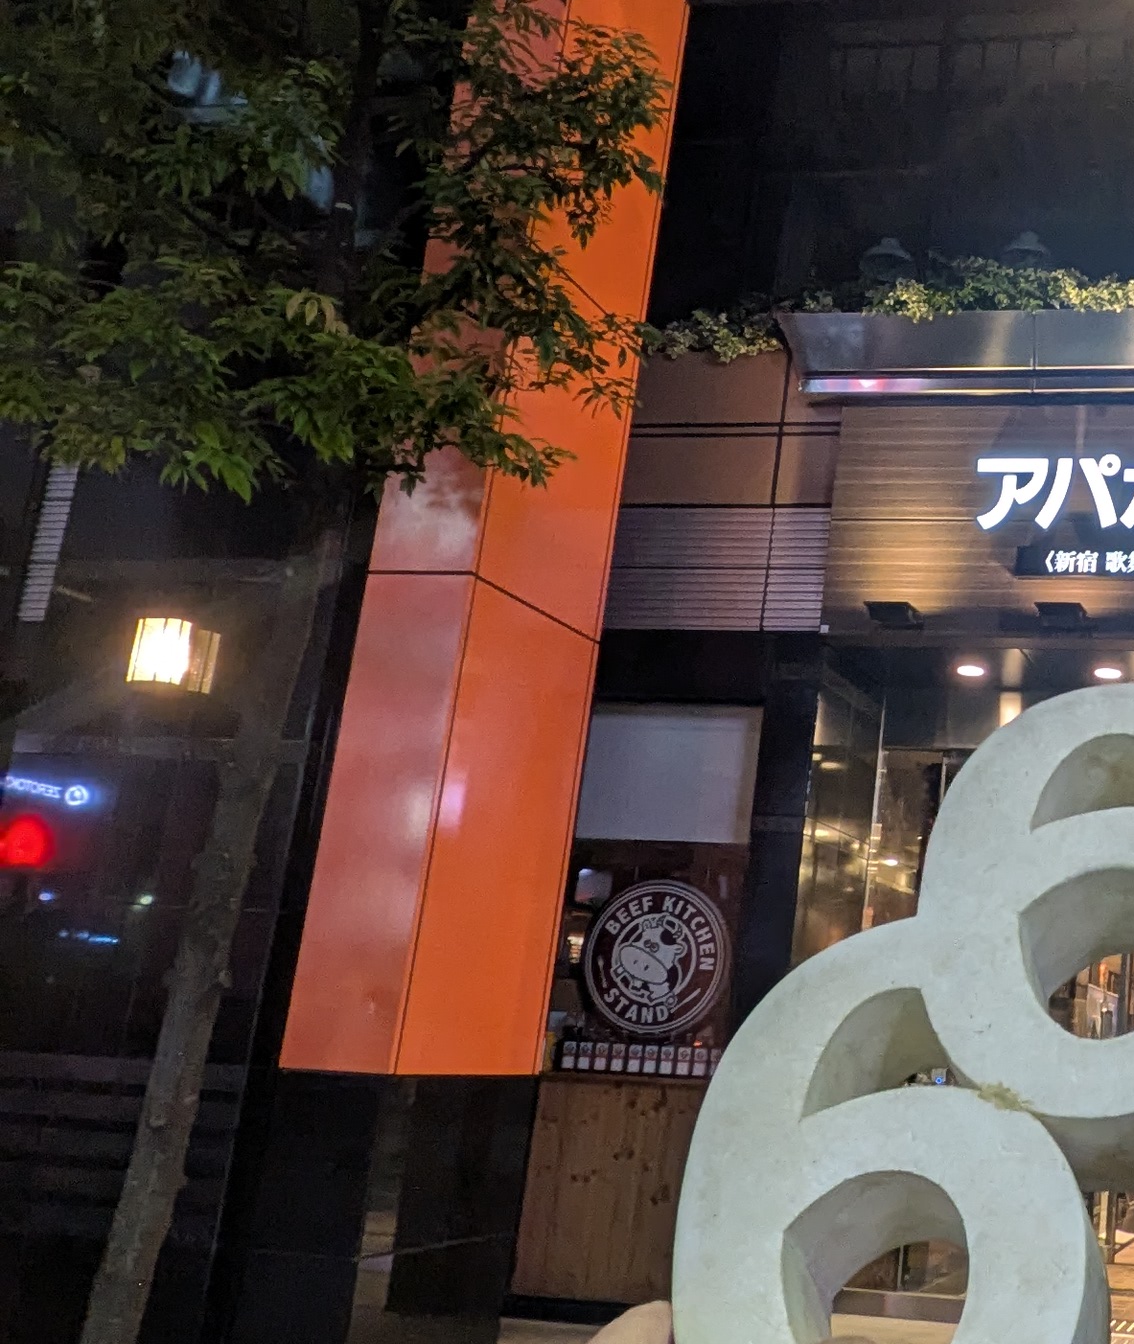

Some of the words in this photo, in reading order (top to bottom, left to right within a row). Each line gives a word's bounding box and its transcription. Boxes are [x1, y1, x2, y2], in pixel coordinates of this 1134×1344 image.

[606, 896, 653, 935] BEEF
[662, 896, 716, 971] KITCHEN
[604, 987, 669, 1023] STAND
